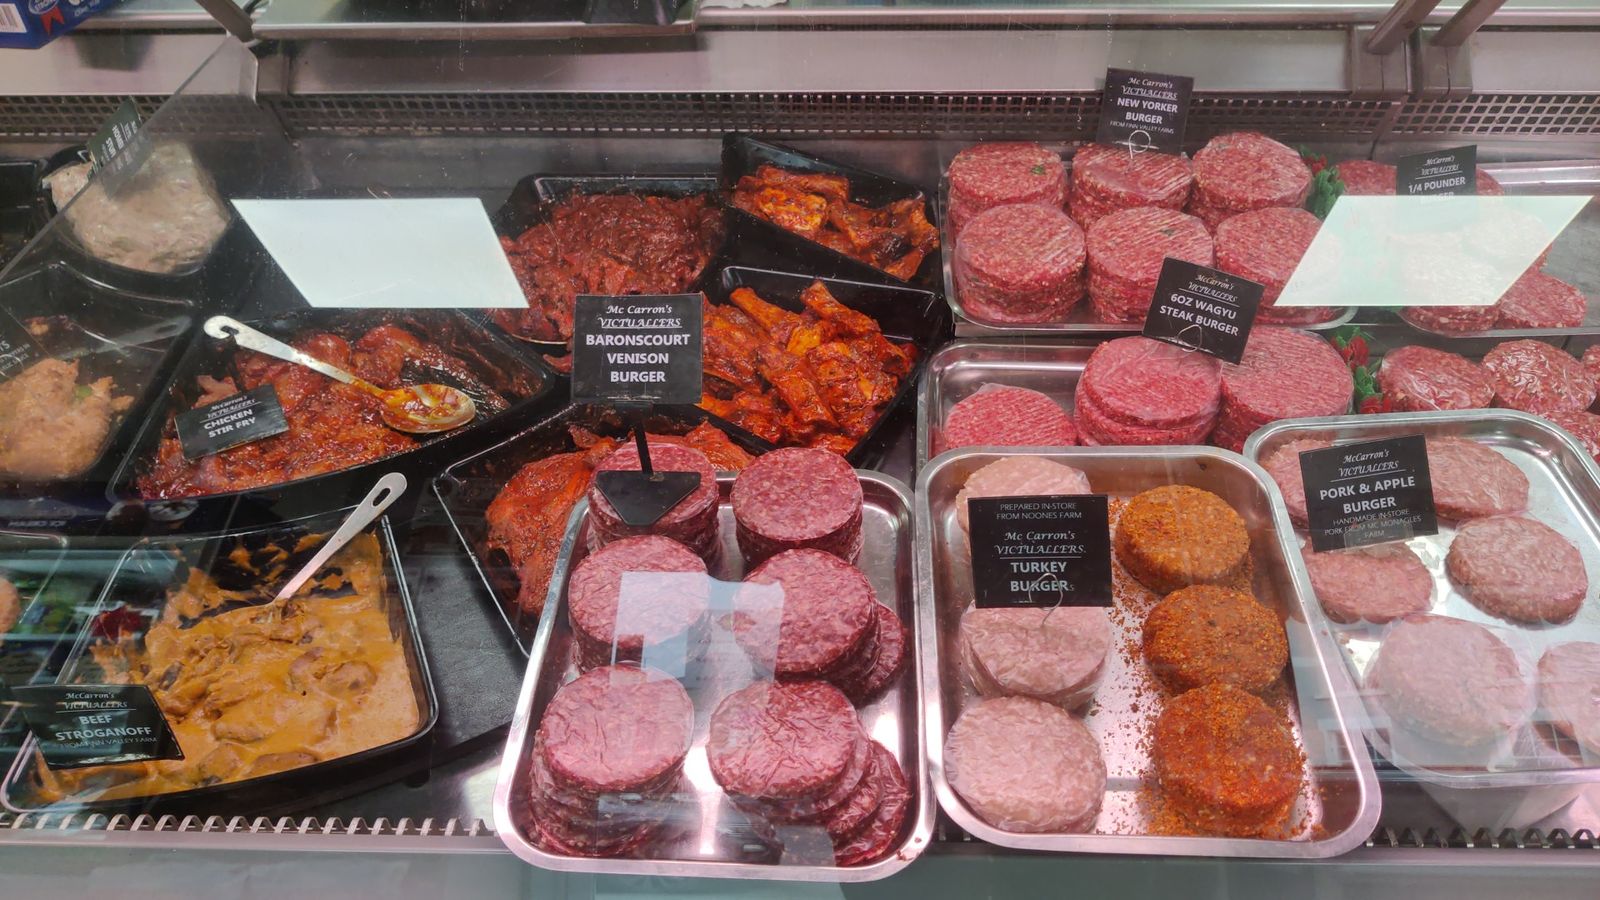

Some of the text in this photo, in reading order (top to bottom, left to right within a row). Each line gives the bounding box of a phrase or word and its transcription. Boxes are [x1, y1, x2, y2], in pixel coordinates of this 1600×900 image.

[1117, 97, 1178, 113] NEW YORKER
[1125, 111, 1162, 124] BURGER
[1408, 176, 1466, 193] 1/4 POUNDER
[1195, 274, 1234, 291] McCarron's
[1188, 282, 1238, 302] VICTUALLERS
[606, 304, 672, 314] Mc Carron's
[1195, 299, 1237, 320] WAGYU
[597, 317, 682, 328] VICTUALLERS
[1159, 305, 1239, 336] STEAK BURGER
[586, 334, 691, 345] BARONSCOURT
[606, 353, 669, 364] VENISON
[610, 371, 666, 382] BURGER
[204, 408, 253, 429] CHICKEN
[208, 417, 256, 438] STIR FRY
[1343, 449, 1390, 464] McCarron's
[1338, 460, 1399, 477] VICTUALLERS
[1320, 476, 1416, 500] PORK & APPLE
[1000, 502, 1077, 511] PREPARED IN-STORE
[1343, 496, 1396, 514] BURGER
[996, 512, 1020, 520] FROM
[1059, 511, 1082, 519] FARM
[1333, 513, 1377, 526] HANDMADE
[1026, 530, 1076, 540] Carron's
[1324, 527, 1343, 536] PORK
[1364, 530, 1384, 538] FARM
[1010, 561, 1067, 573] TURKEY
[66, 692, 115, 700] McCarron's
[78, 714, 113, 725] BEEF
[55, 727, 152, 741] STROGANOFF
